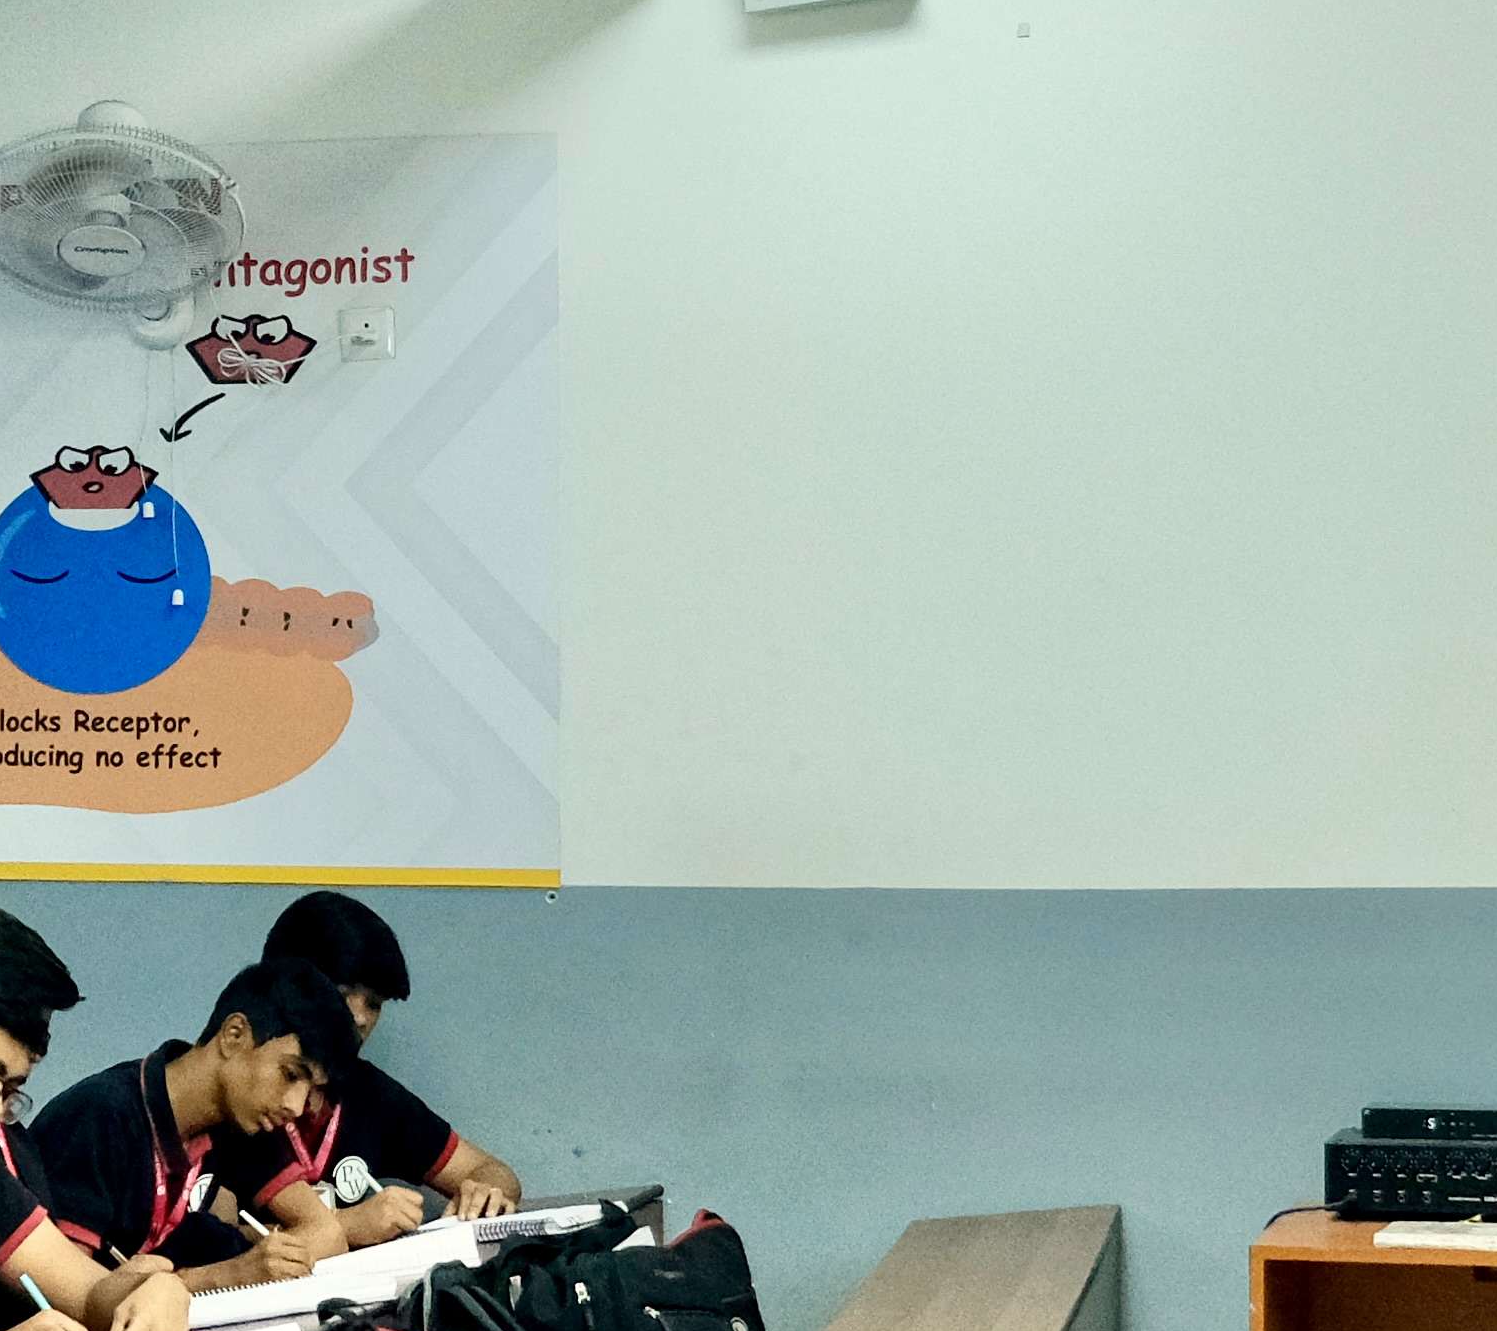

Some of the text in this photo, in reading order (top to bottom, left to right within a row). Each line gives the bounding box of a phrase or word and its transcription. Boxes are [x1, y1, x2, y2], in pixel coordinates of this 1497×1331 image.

[191, 246, 416, 297] ntagonist
[74, 709, 199, 740] Receptor,
[96, 750, 124, 767] no
[136, 744, 222, 769] effect
